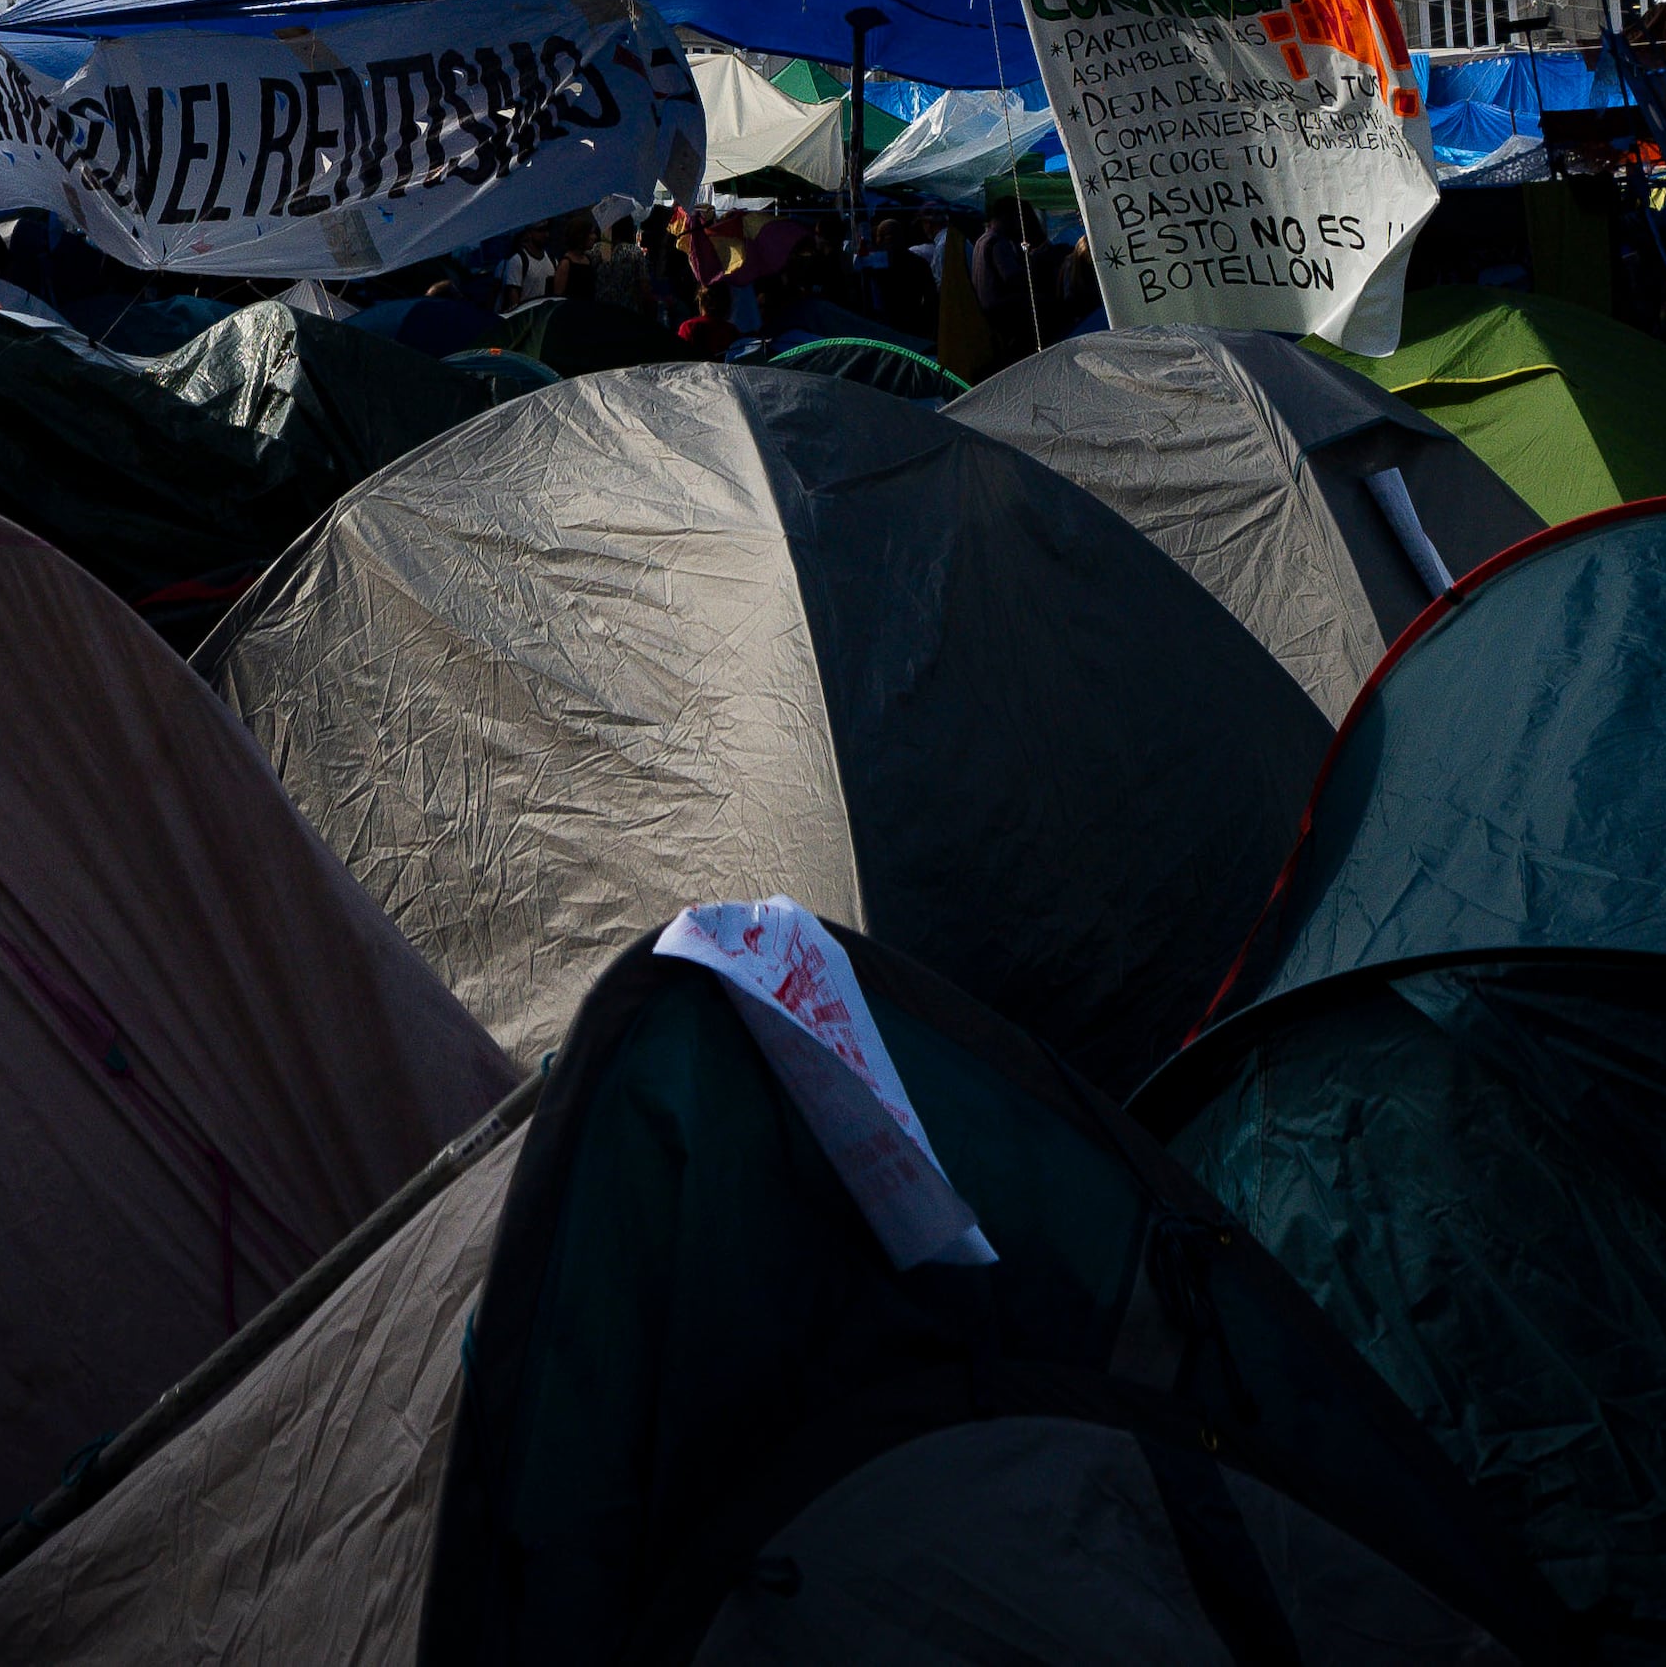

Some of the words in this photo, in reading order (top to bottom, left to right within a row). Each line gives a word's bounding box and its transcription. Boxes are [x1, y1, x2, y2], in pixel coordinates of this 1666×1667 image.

[1071, 43, 1209, 88] ASAMBLEAS
[1082, 85, 1172, 128] DEJA
[1175, 74, 1310, 108] DESCANSAR
[1313, 79, 1339, 103] A
[1329, 111, 1358, 133] NO
[1093, 110, 1298, 156] COMPAÑERAS
[1101, 147, 1229, 189] RECOGE
[1239, 145, 1278, 169] TU
[1111, 180, 1264, 231] BASURA
[1126, 219, 1237, 266] ESTO
[1250, 214, 1306, 255] NO
[1317, 214, 1366, 251] ES
